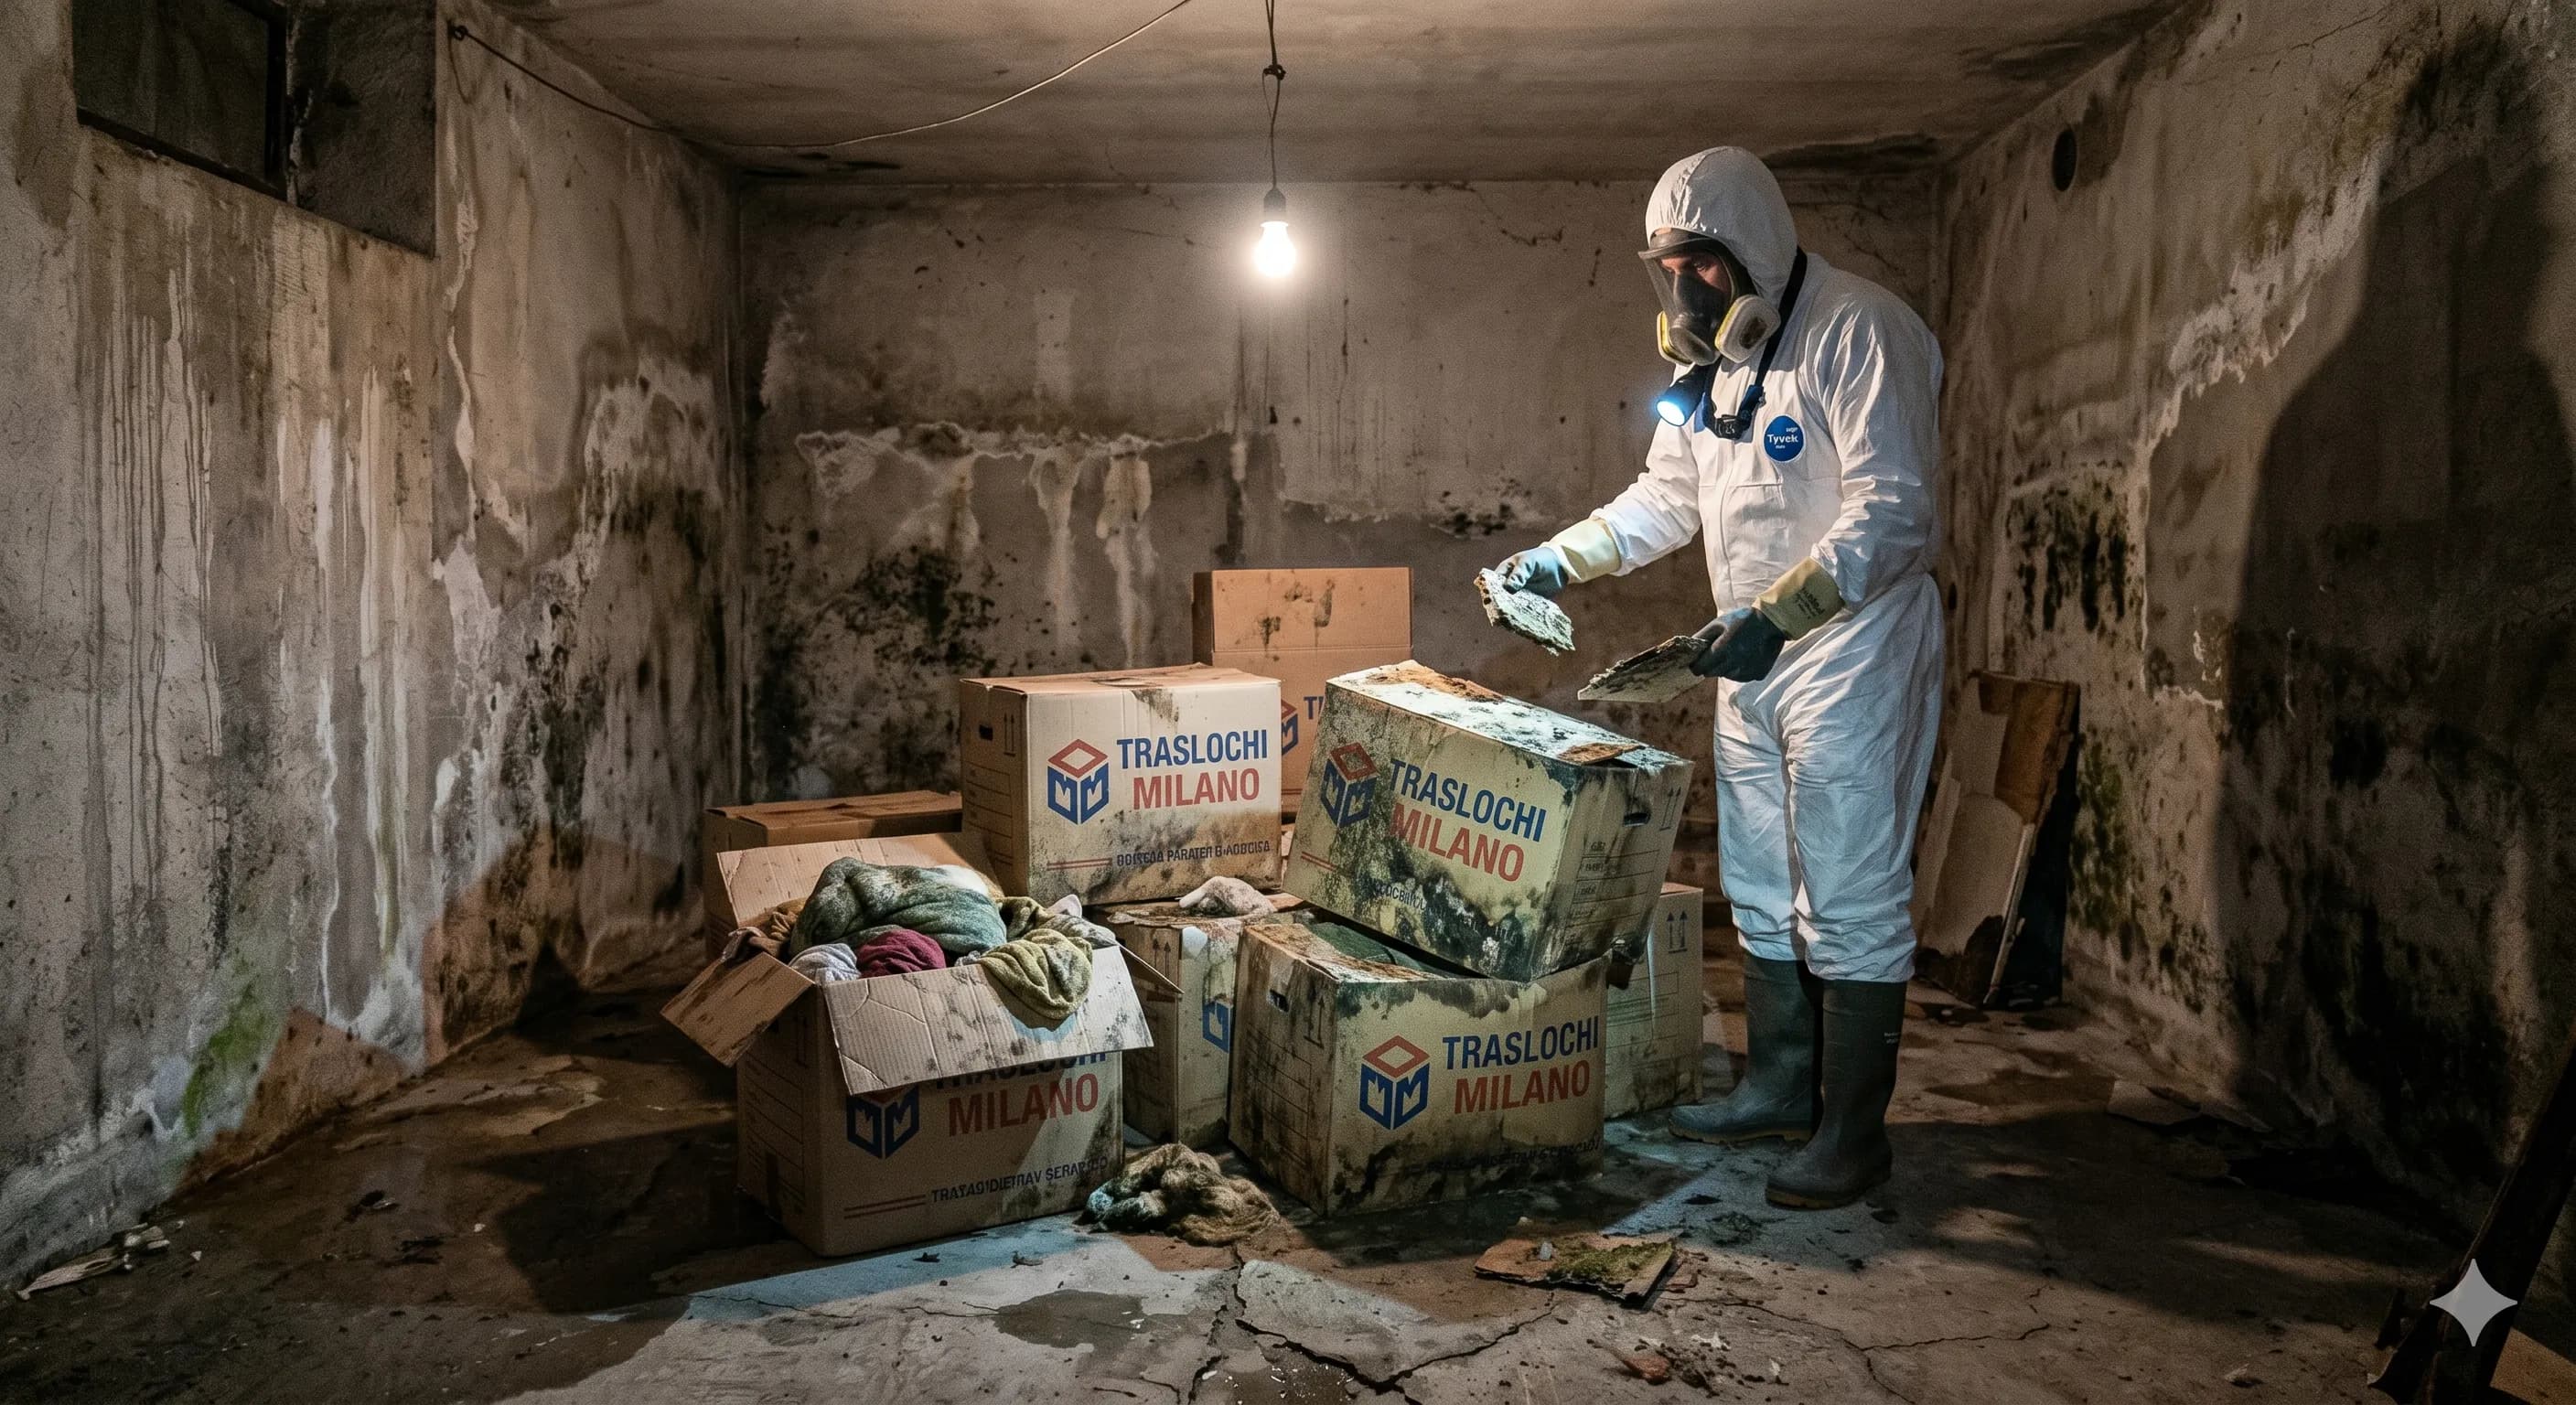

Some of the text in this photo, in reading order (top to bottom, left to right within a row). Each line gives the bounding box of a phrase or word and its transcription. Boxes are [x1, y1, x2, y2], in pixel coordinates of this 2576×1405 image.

[1766, 434, 1798, 445] Tyvek
[1116, 729, 1268, 769] TRASLOCHI
[1132, 767, 1260, 810] MILANO
[1390, 757, 1547, 842] TRASLOCHI
[1390, 801, 1525, 882] MILANO
[1442, 1015, 1599, 1070] TRASLOCHI
[949, 1073, 1099, 1137] MILANO
[1454, 1059, 1590, 1114] MILANO
